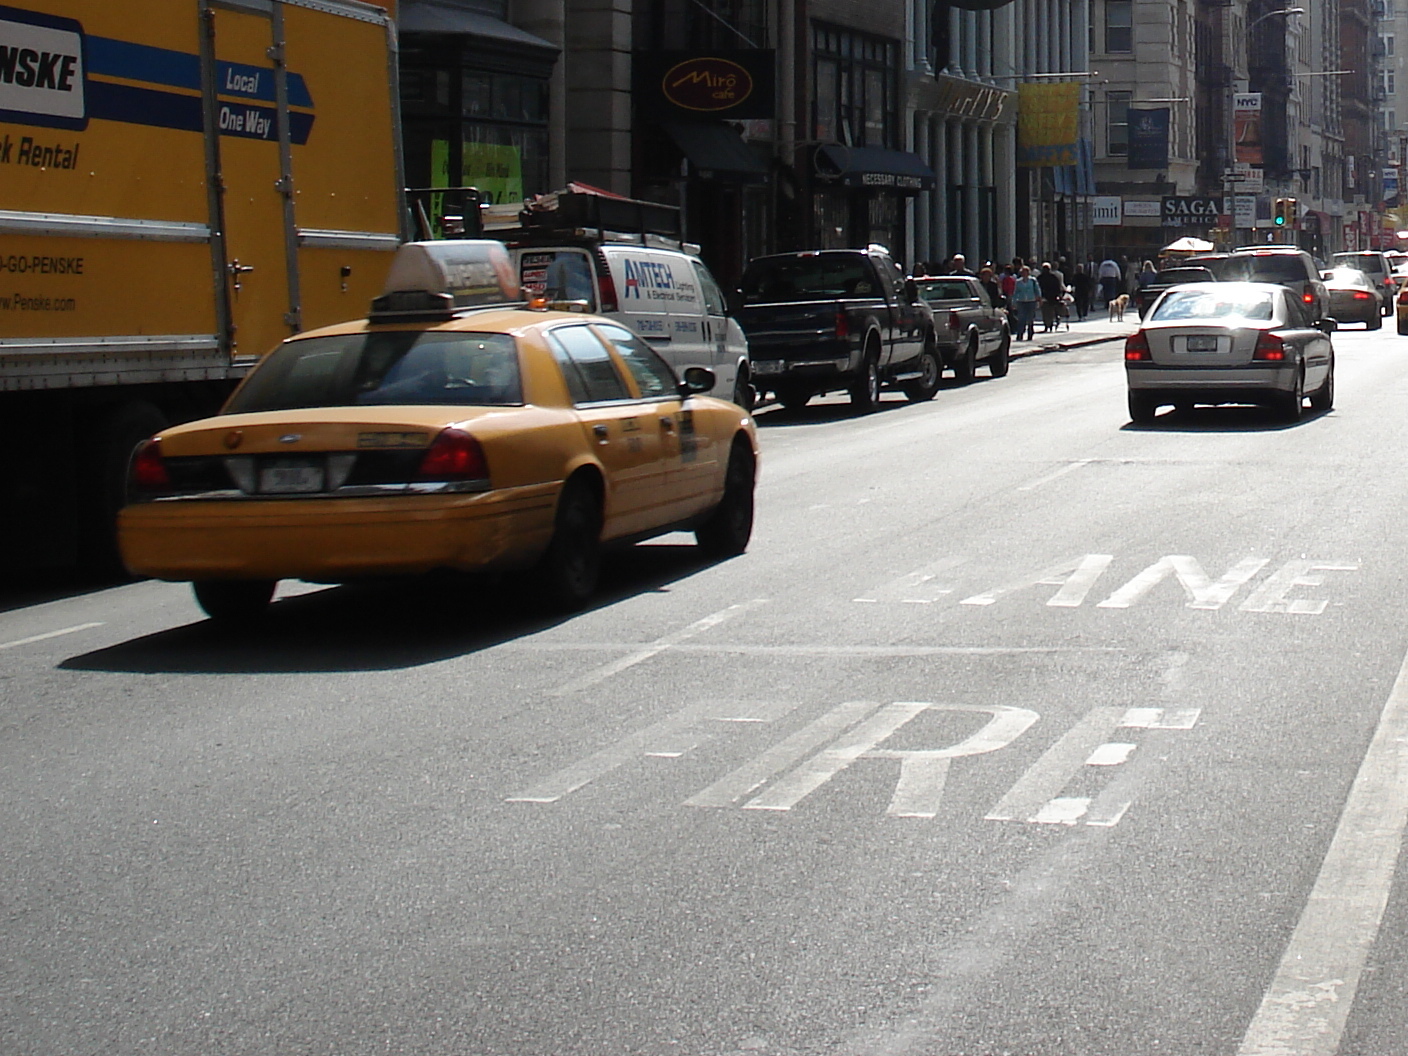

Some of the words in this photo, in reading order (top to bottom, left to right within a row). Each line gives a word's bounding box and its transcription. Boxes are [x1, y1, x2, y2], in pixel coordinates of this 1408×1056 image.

[226, 67, 259, 94] Local
[219, 106, 243, 132] One
[245, 111, 271, 139] Way
[18, 137, 80, 170] Rental
[1165, 199, 1219, 215] SAGA
[624, 258, 675, 300] AMTECH
[852, 553, 1361, 615] LANE
[505, 700, 1201, 827] FIRE
